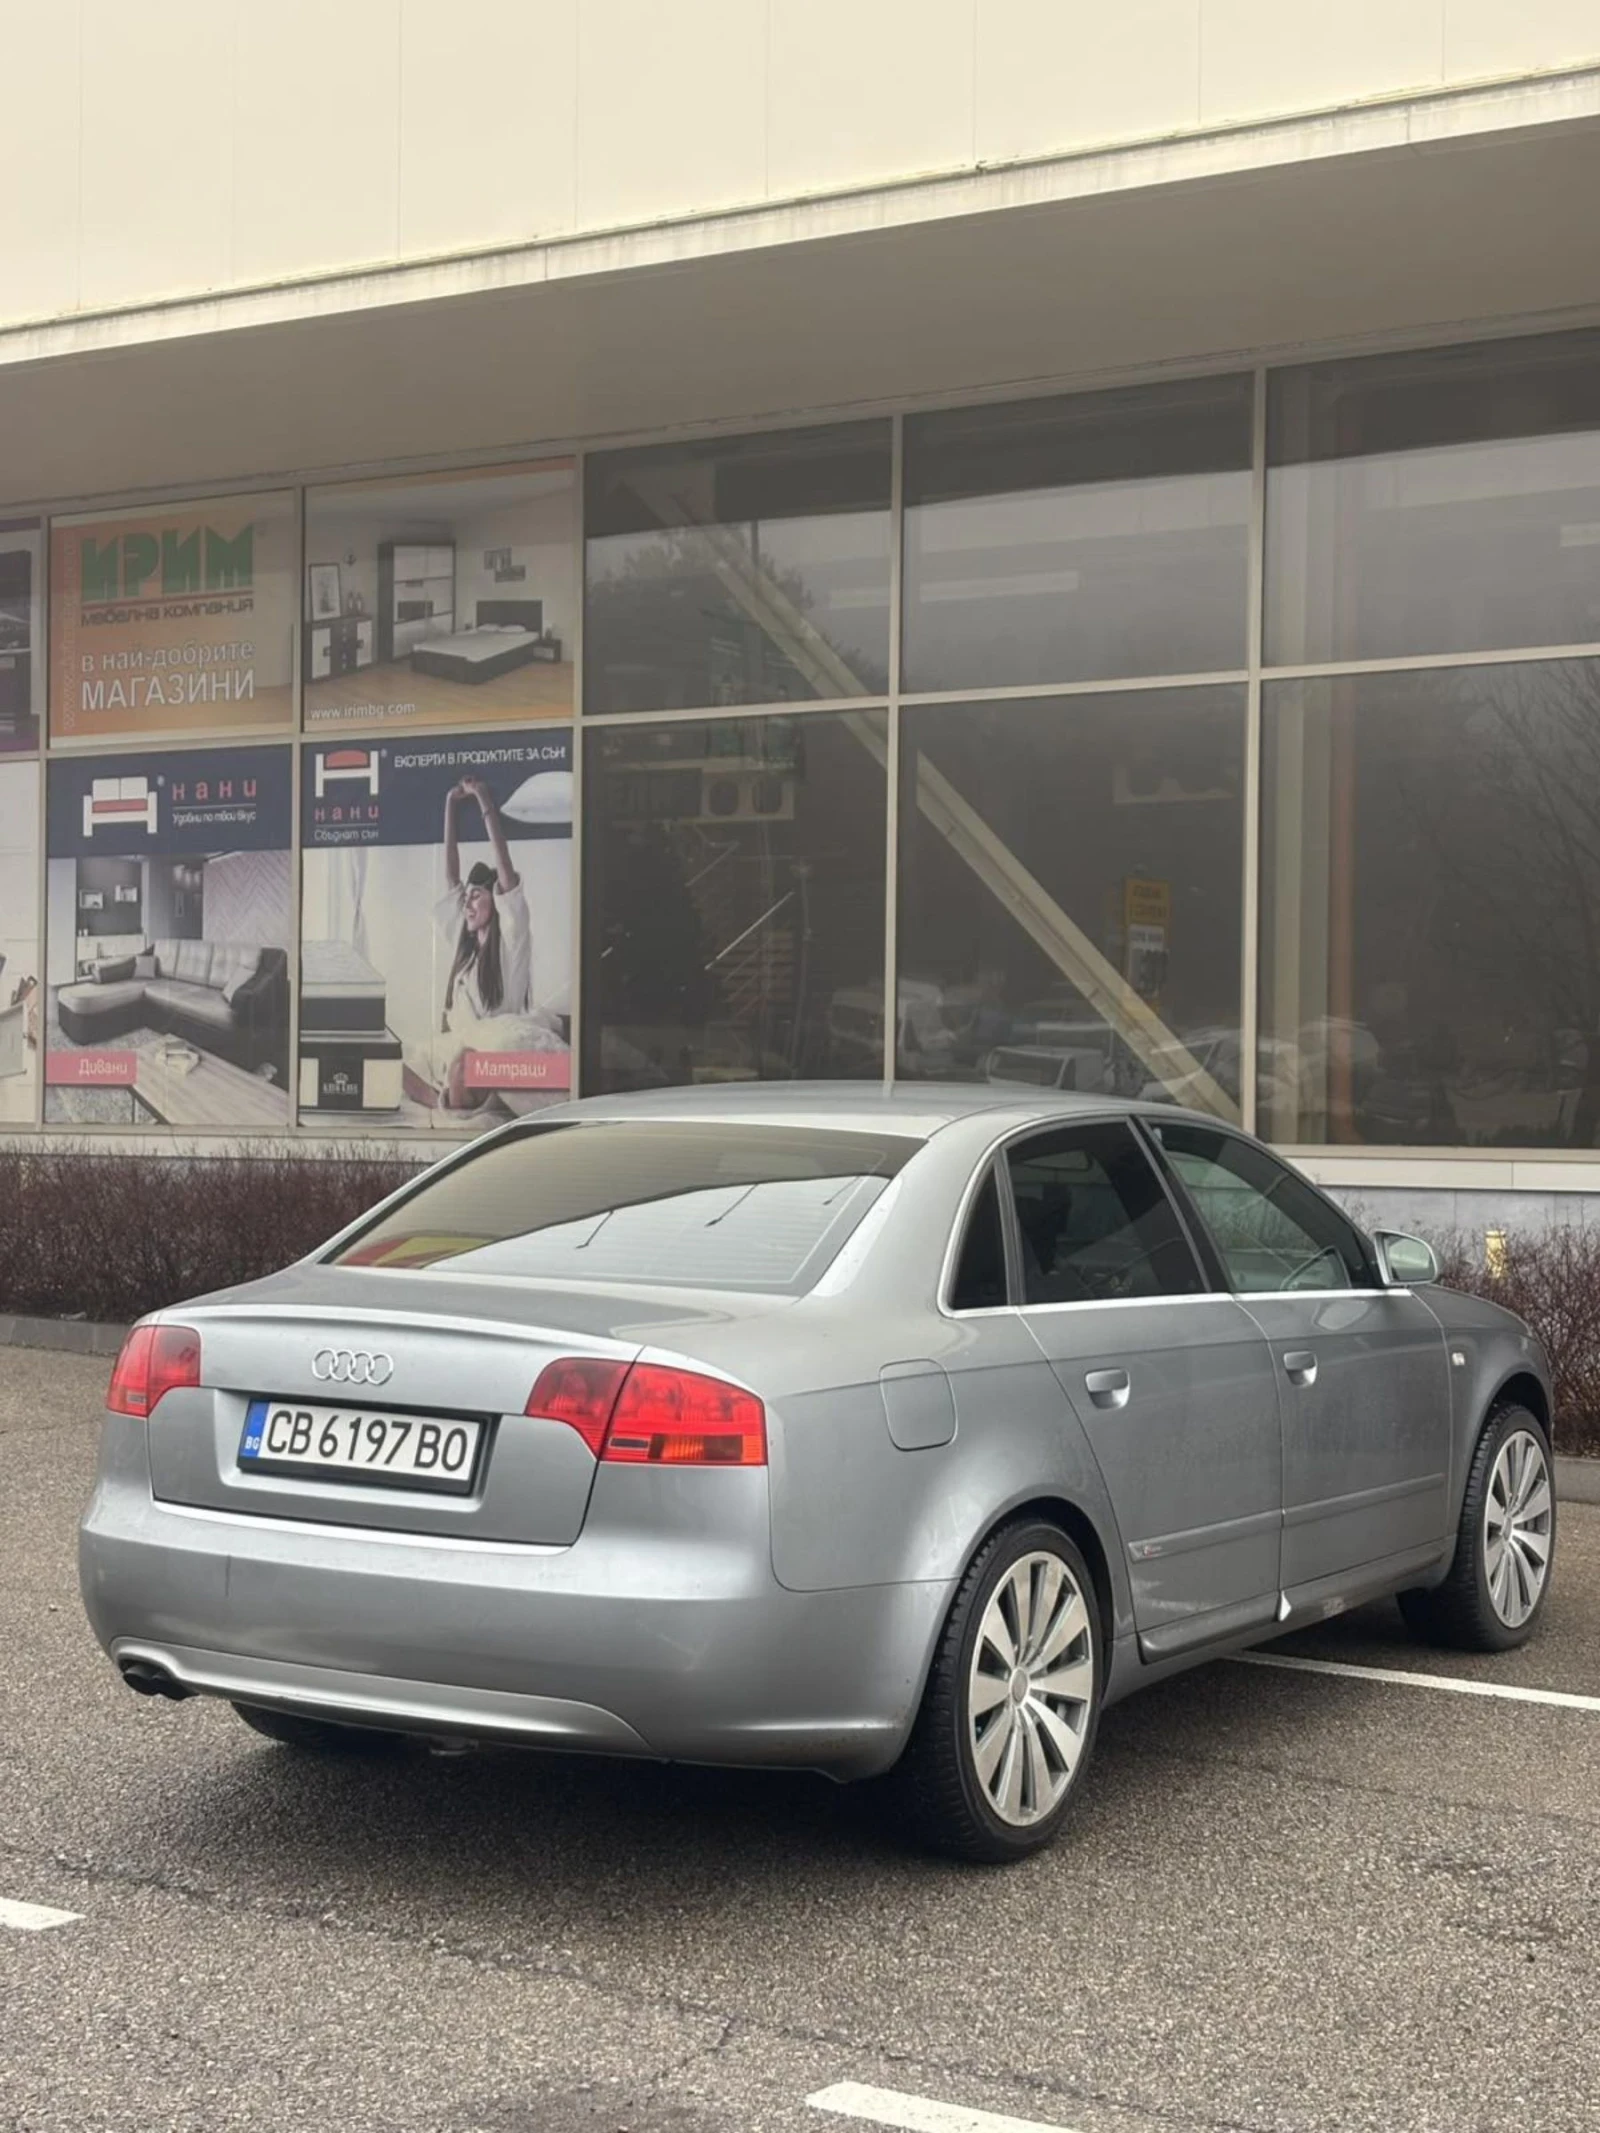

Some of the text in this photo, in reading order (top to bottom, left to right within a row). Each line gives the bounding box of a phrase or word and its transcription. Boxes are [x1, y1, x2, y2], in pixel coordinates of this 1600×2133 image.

[80, 523, 254, 603] ИРИМ
[82, 640, 255, 672] в най-добрите
[82, 669, 254, 711] МАГАЗИНИ
[310, 703, 416, 720] www.irimbg.com
[394, 753, 446, 768] ЕКСПЕРТИ
[447, 752, 456, 766] В
[456, 748, 524, 765] ПРОДУКТИТЕ
[526, 747, 541, 761] ЗА
[79, 1058, 128, 1077] Дивани
[475, 1060, 547, 1081] Матраци
[244, 1436, 261, 1450] BG
[318, 1414, 413, 1466] 6197
